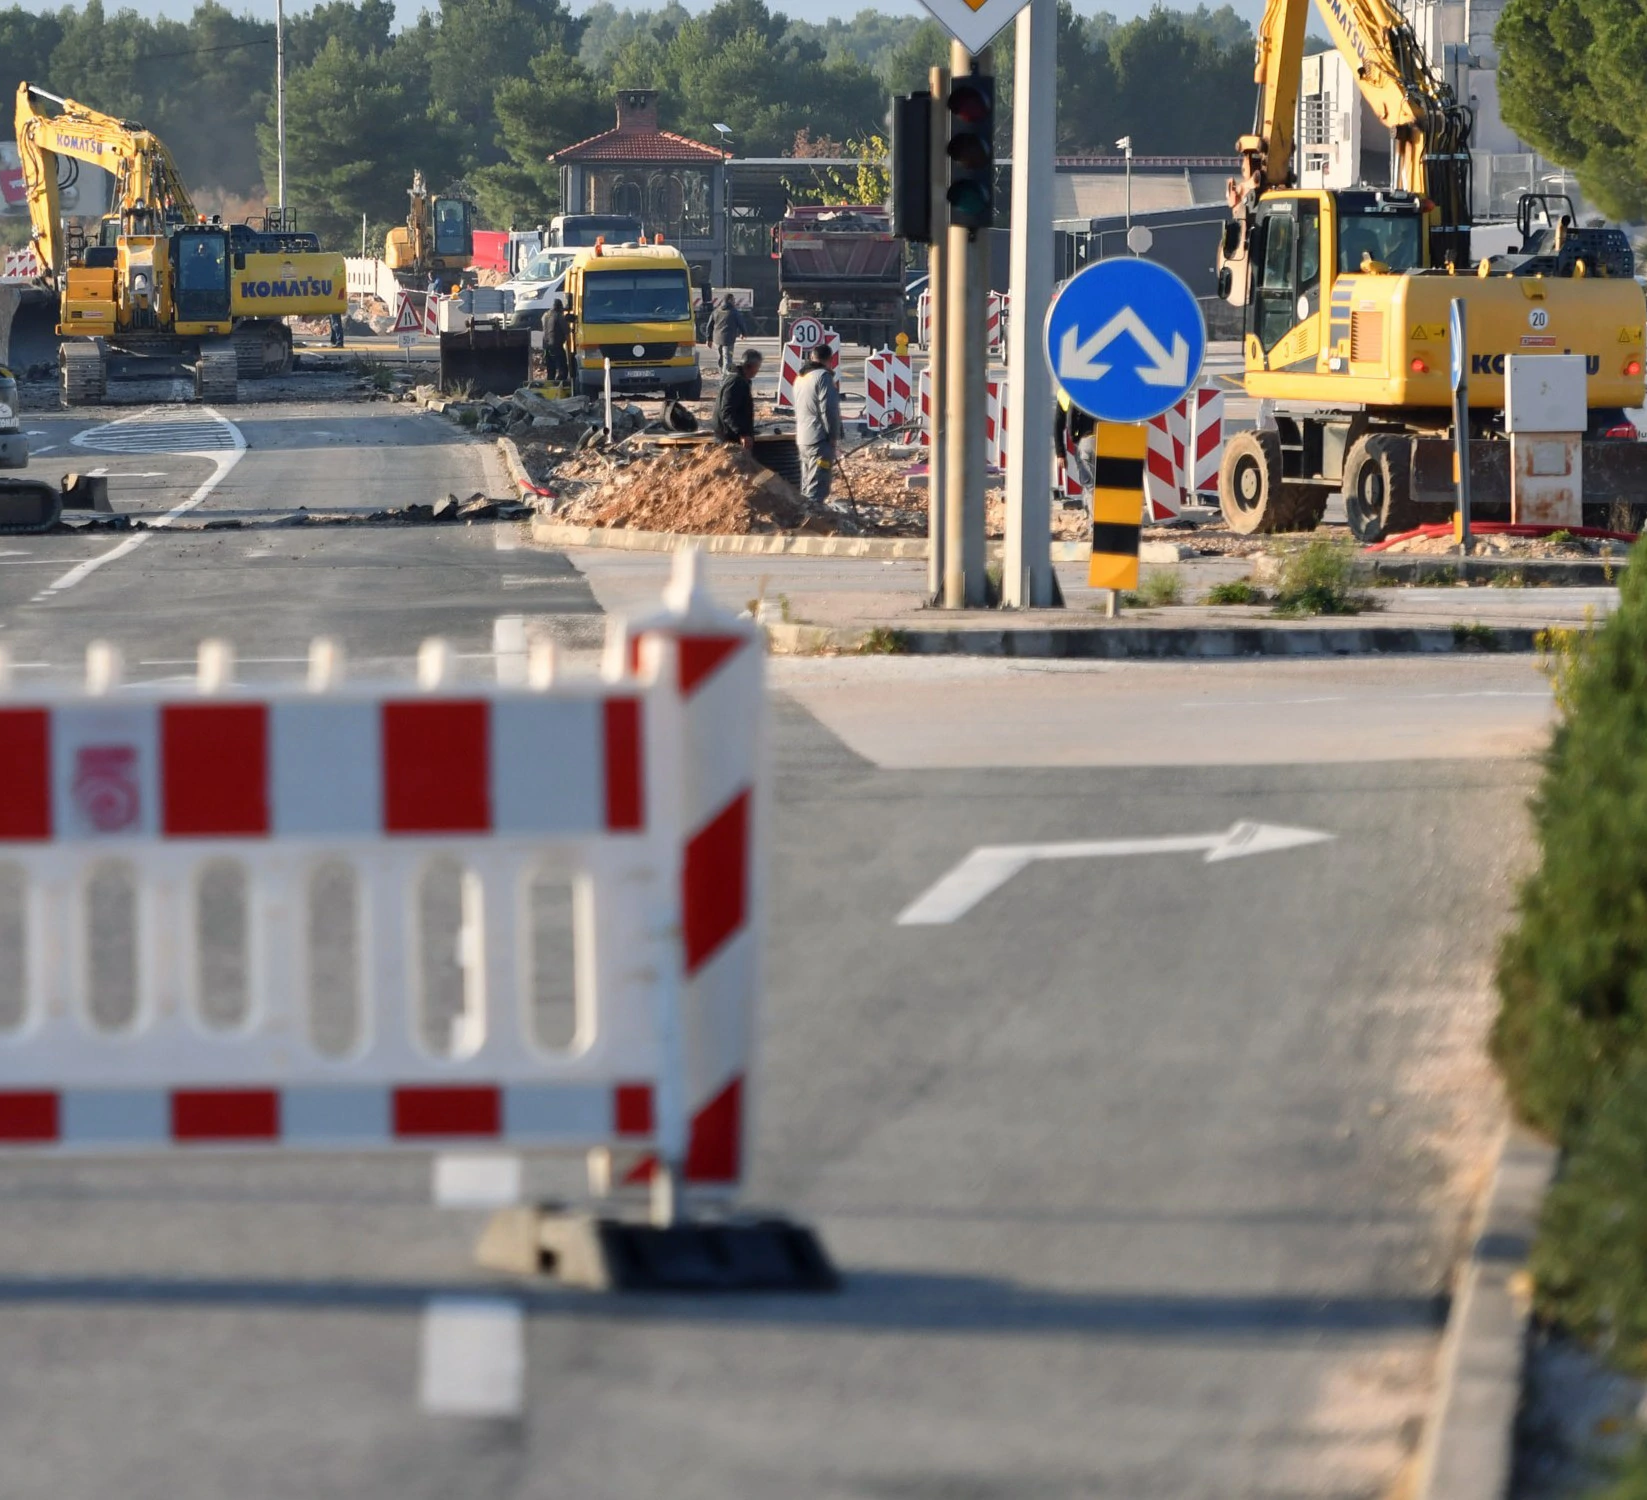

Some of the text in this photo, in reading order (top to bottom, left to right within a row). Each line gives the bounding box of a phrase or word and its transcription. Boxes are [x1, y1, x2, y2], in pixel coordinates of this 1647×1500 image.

[57, 133, 103, 155] KOMATSU
[241, 276, 332, 298] KOMATSU
[1532, 312, 1546, 327] 20
[796, 325, 816, 343] 30
